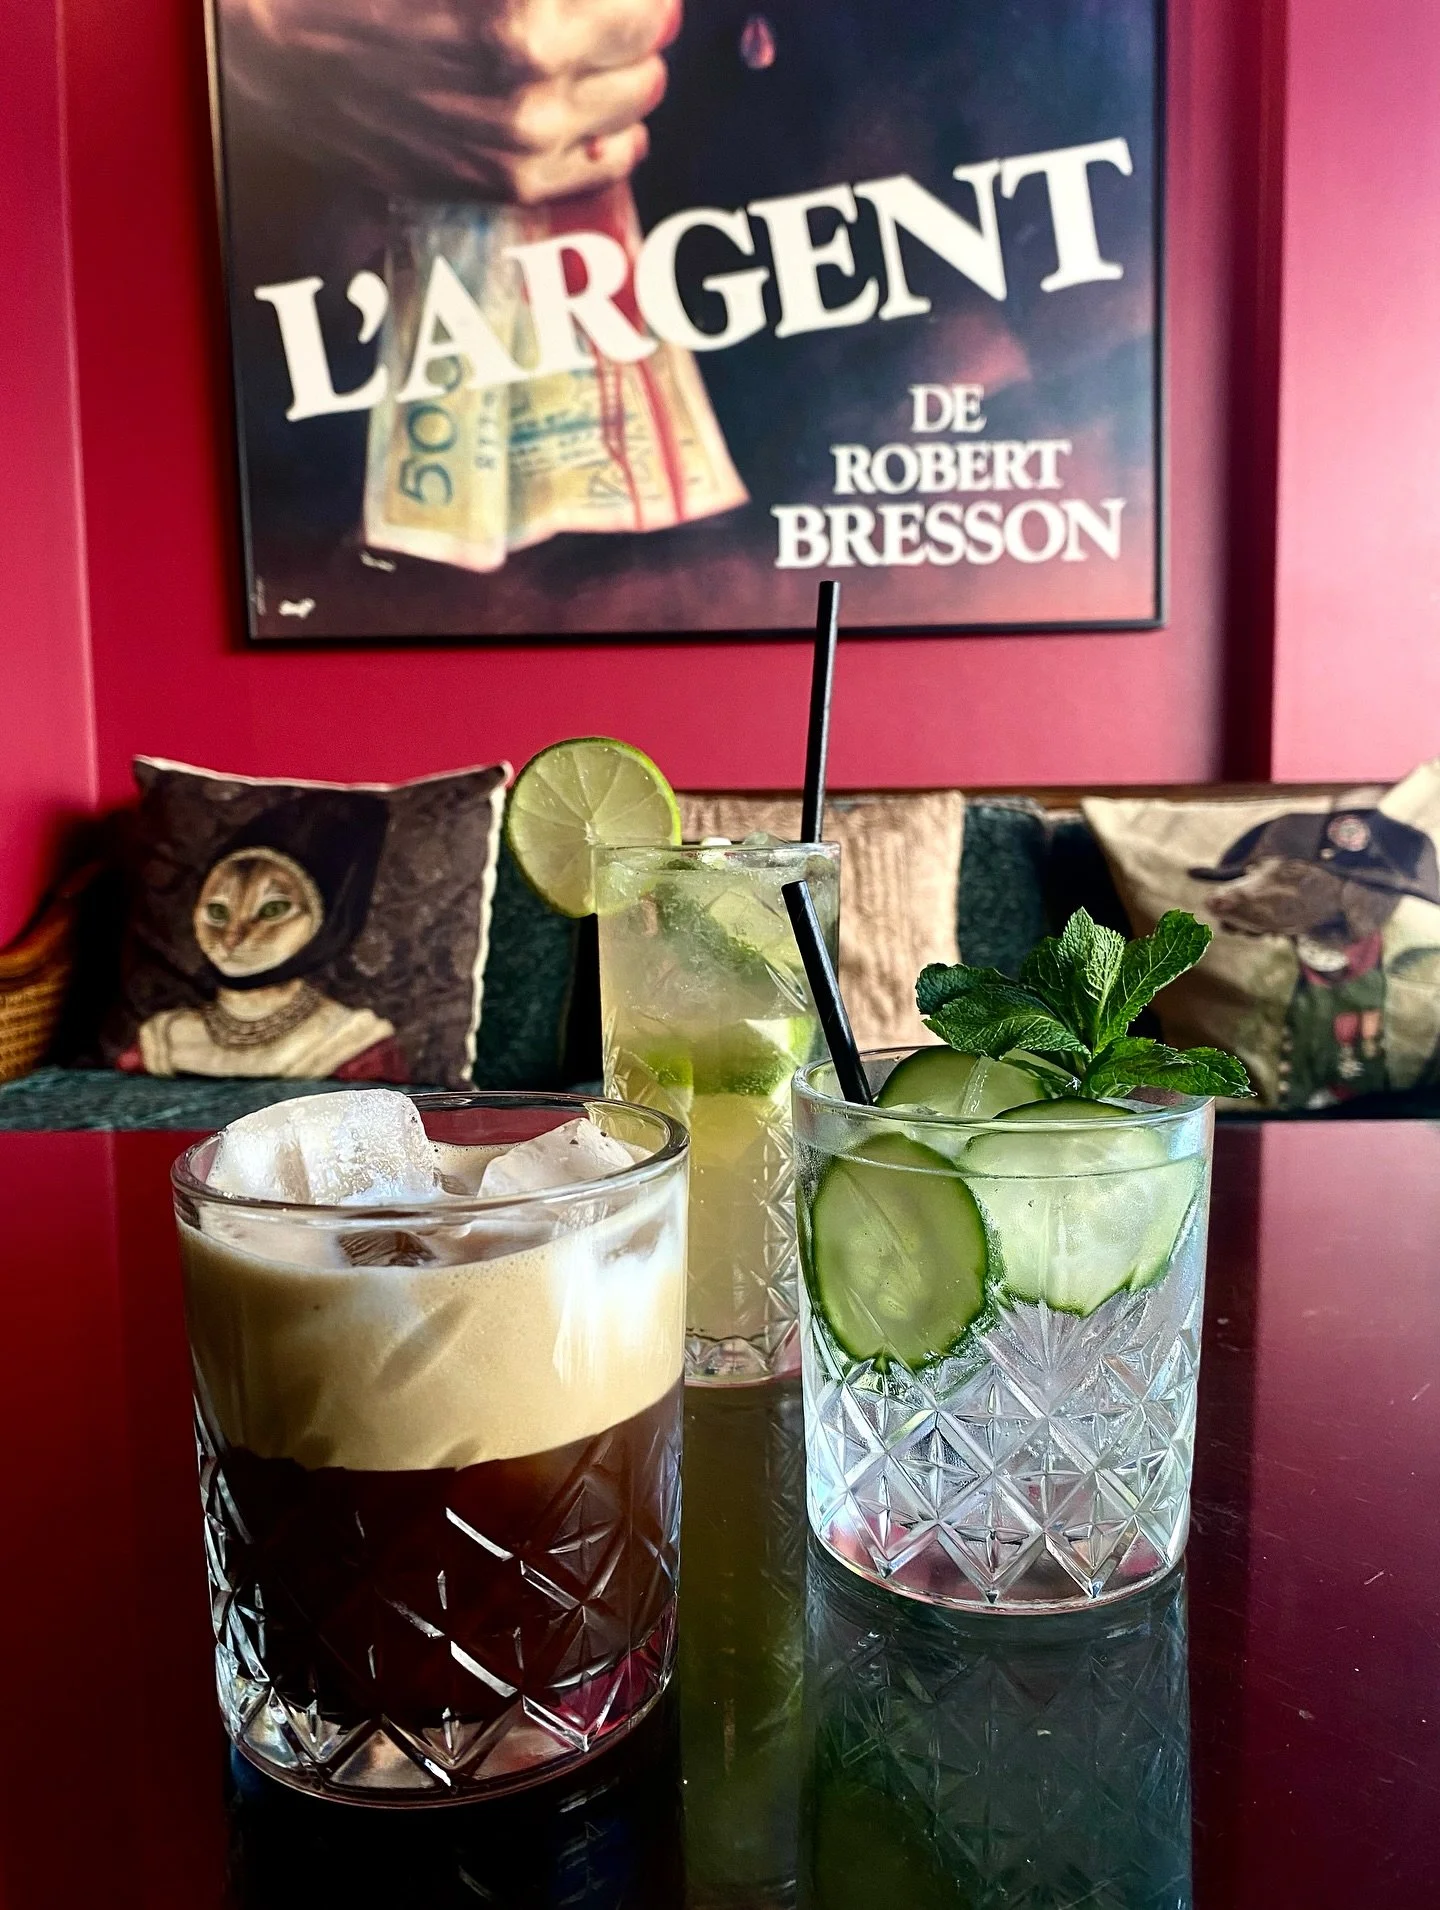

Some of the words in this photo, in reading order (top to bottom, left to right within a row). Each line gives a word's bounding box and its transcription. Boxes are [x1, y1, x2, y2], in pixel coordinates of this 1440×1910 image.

[254, 137, 1133, 422] L'ARGENT
[908, 383, 987, 433] DE
[829, 439, 1073, 495] ROBERT
[770, 498, 1127, 568] BRESSON
